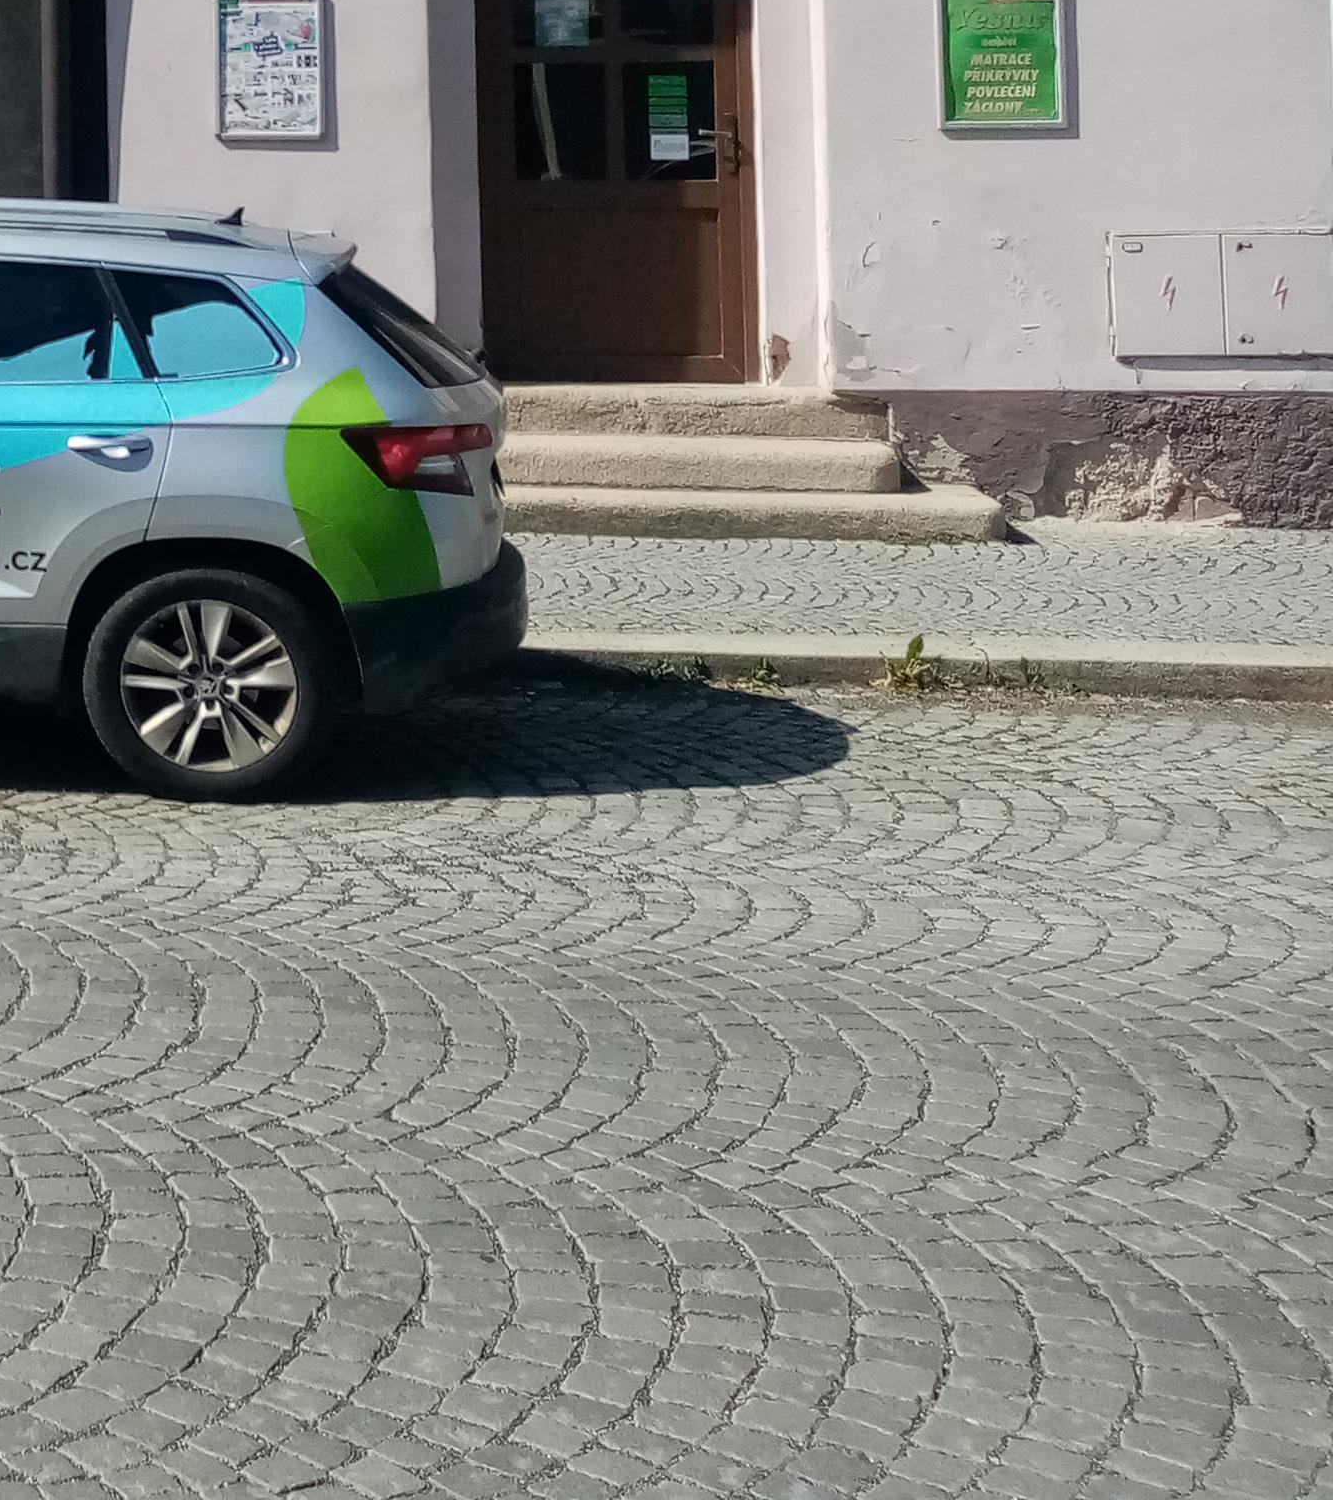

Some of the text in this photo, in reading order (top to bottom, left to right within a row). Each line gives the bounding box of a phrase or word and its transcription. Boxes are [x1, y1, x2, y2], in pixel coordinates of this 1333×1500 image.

[971, 53, 1032, 66] MATRACE
[963, 67, 1039, 82] PŘIKRÝVKY
[967, 83, 1037, 98] POVLEČENÍ
